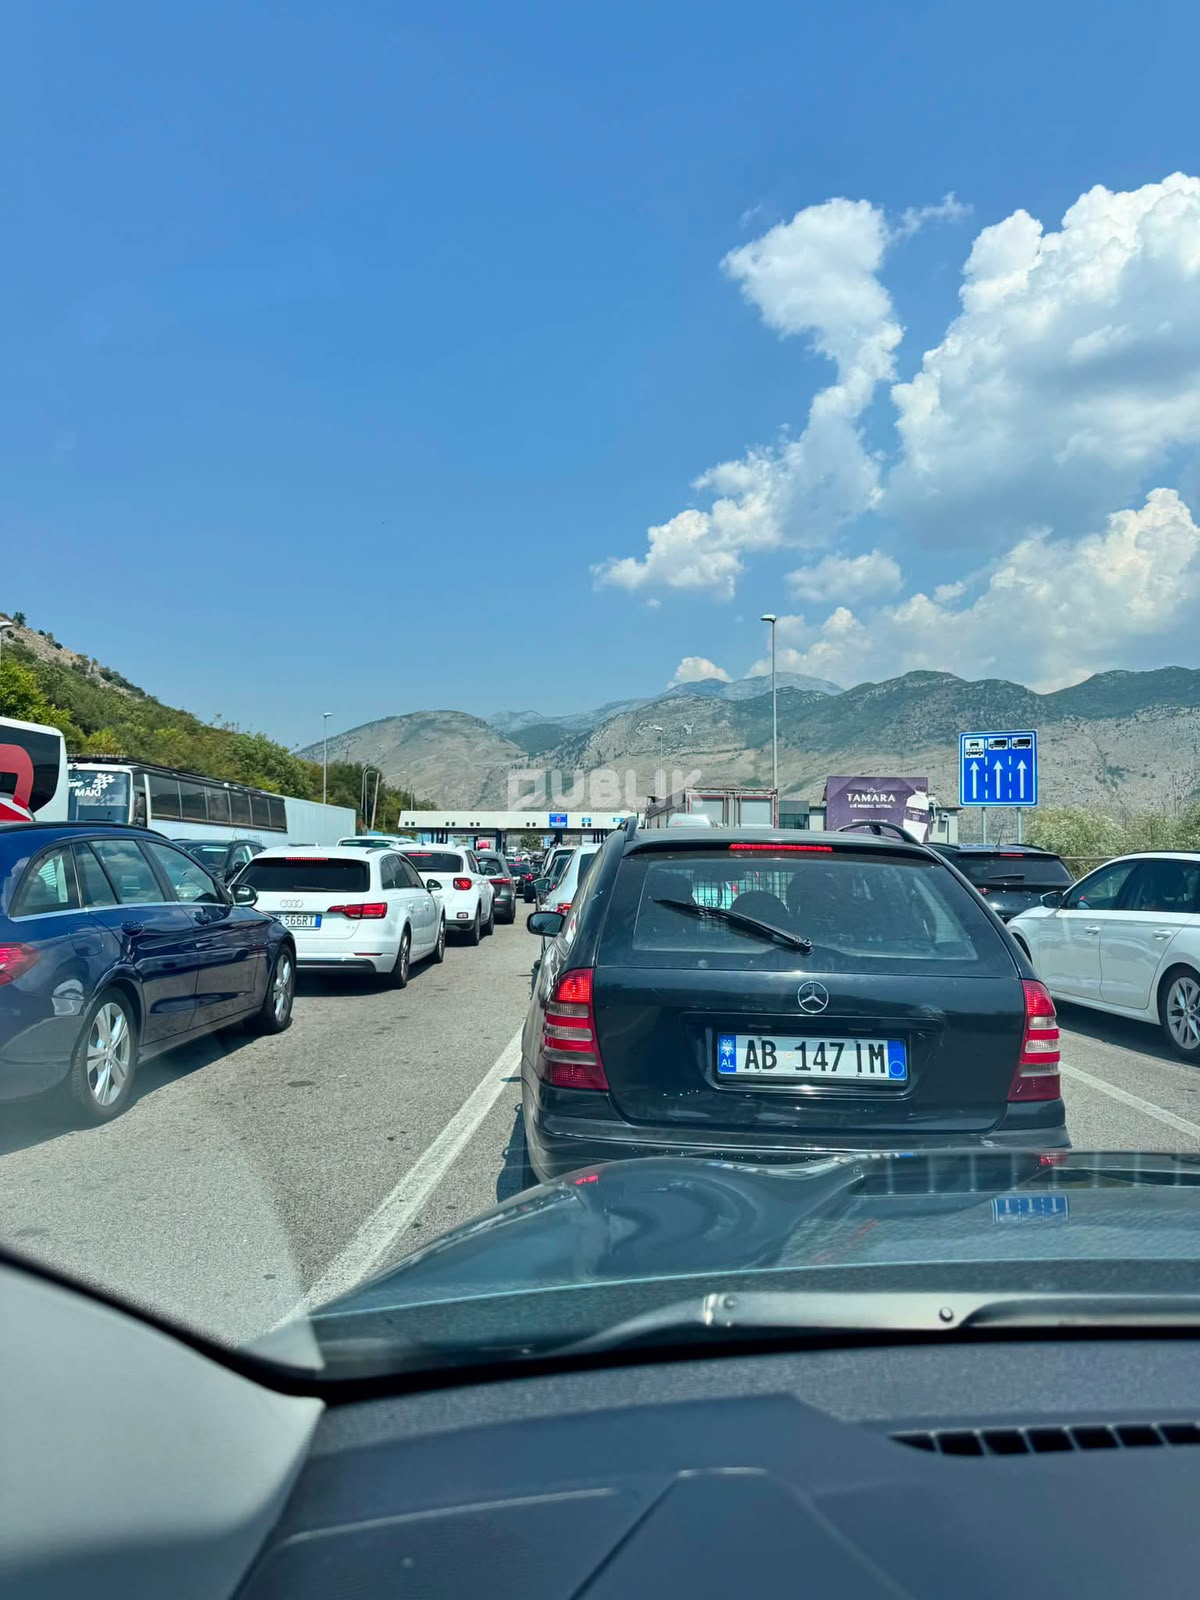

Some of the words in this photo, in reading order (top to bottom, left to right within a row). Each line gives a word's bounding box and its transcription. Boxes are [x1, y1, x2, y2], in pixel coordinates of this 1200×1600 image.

[846, 793, 896, 803] TAMARA
[744, 1039, 777, 1070] AB
[794, 1041, 846, 1072] 147
[856, 1042, 886, 1074] IM
[721, 1058, 734, 1068] AL
